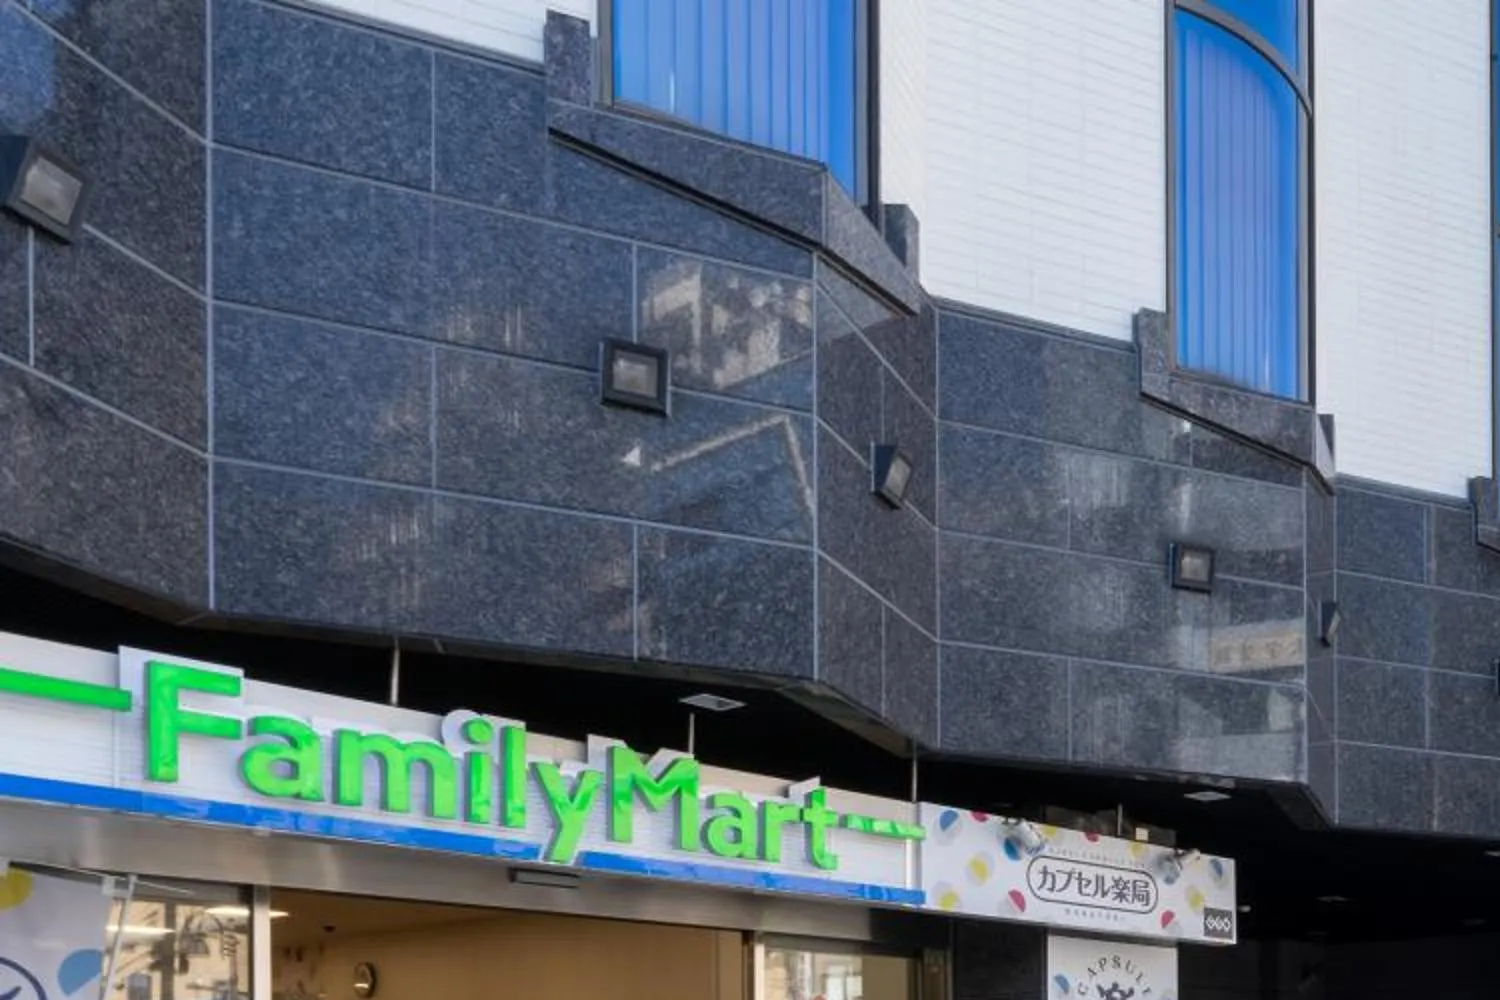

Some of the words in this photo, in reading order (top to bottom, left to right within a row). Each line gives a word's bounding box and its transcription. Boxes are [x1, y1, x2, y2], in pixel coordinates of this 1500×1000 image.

[145, 659, 838, 870] FamilyMart
[1038, 865, 1151, 908] カプセル楽局
